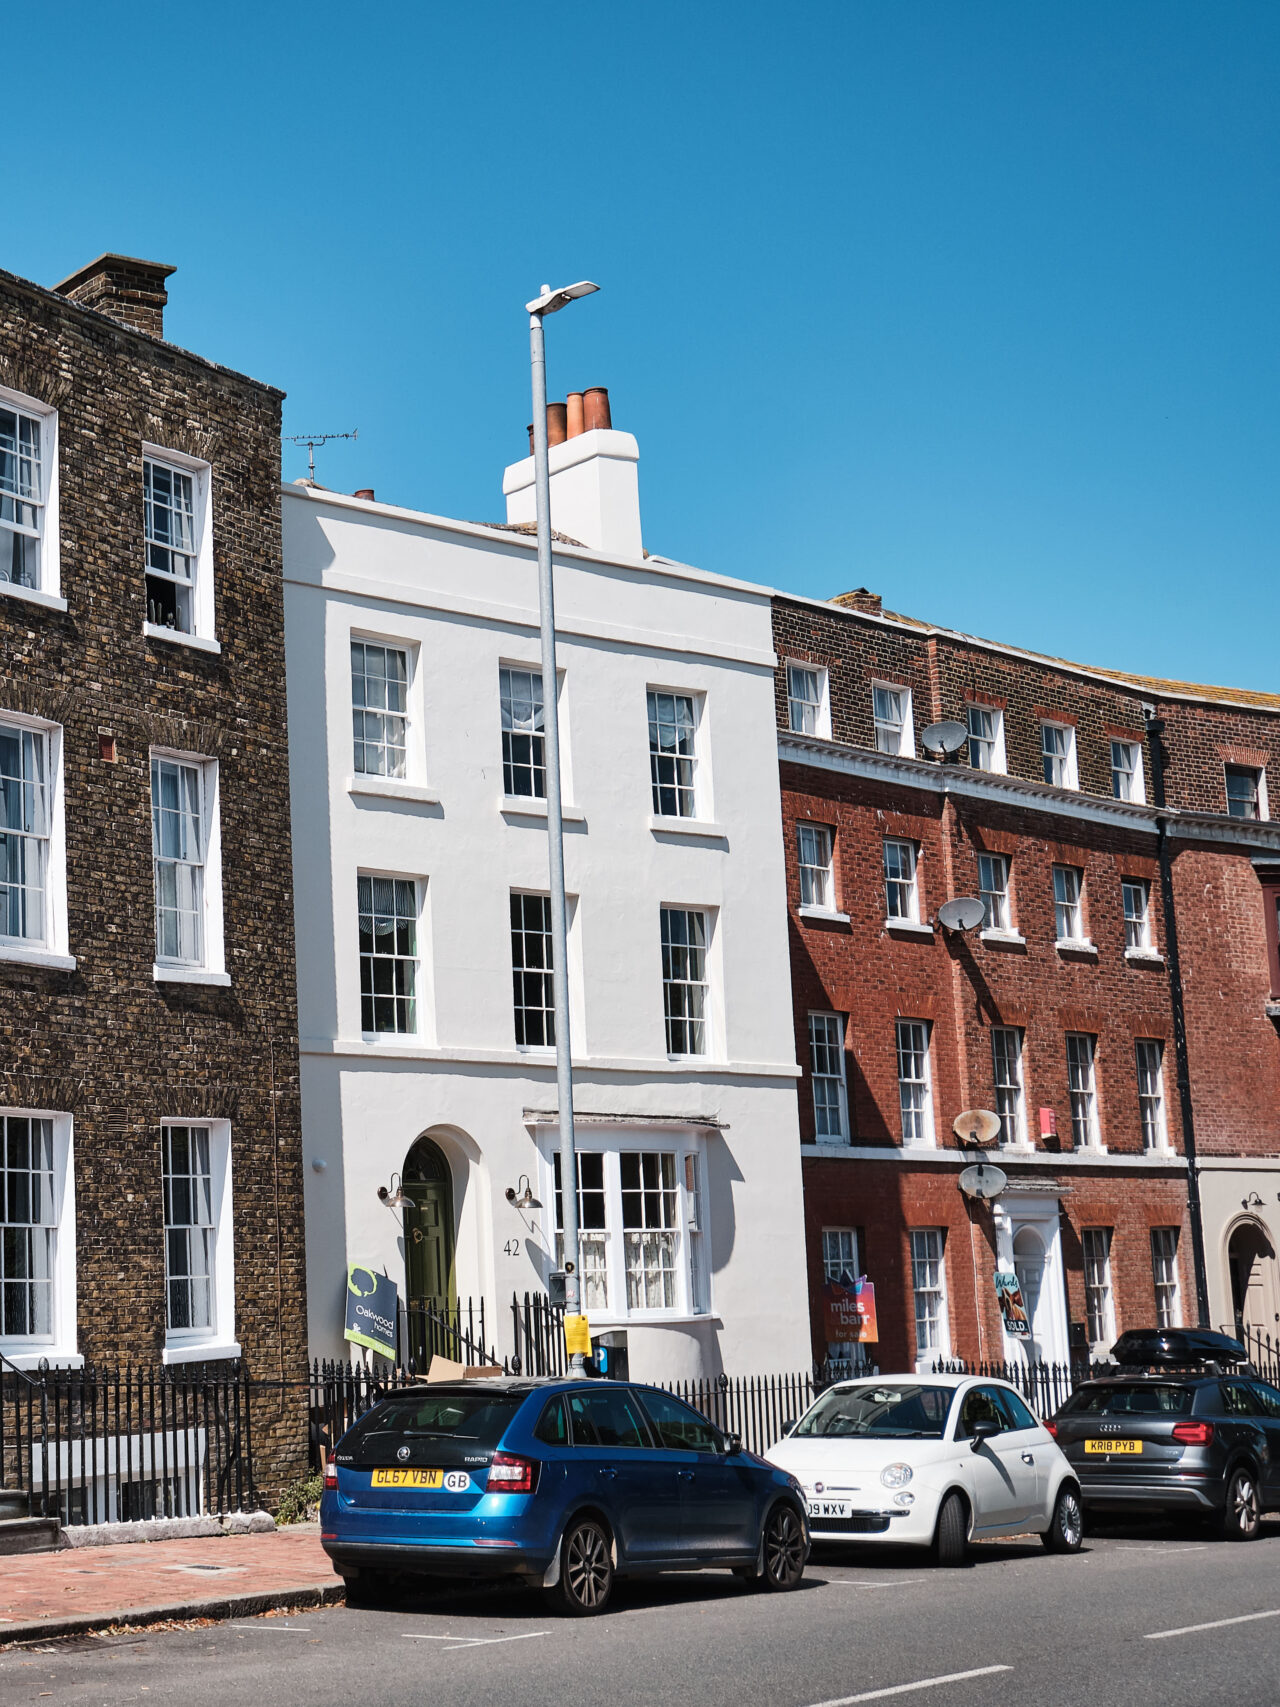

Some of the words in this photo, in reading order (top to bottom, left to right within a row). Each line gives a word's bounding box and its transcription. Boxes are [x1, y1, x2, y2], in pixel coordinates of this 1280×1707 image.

[503, 1238, 520, 1256] 42
[830, 1298, 865, 1313] miles
[355, 1305, 394, 1330] Oakwood
[840, 1312, 870, 1325] barr
[374, 1321, 393, 1338] homes
[835, 1328, 847, 1338] for
[849, 1328, 868, 1338] sale
[1006, 1320, 1025, 1332] SOLD
[593, 1349, 605, 1368] P
[1090, 1441, 1113, 1451] KR18
[1115, 1441, 1135, 1451] PYB
[376, 1470, 409, 1484] GL67
[412, 1470, 437, 1484] VBN
[447, 1474, 468, 1488] GB
[823, 1504, 845, 1515] WXV
